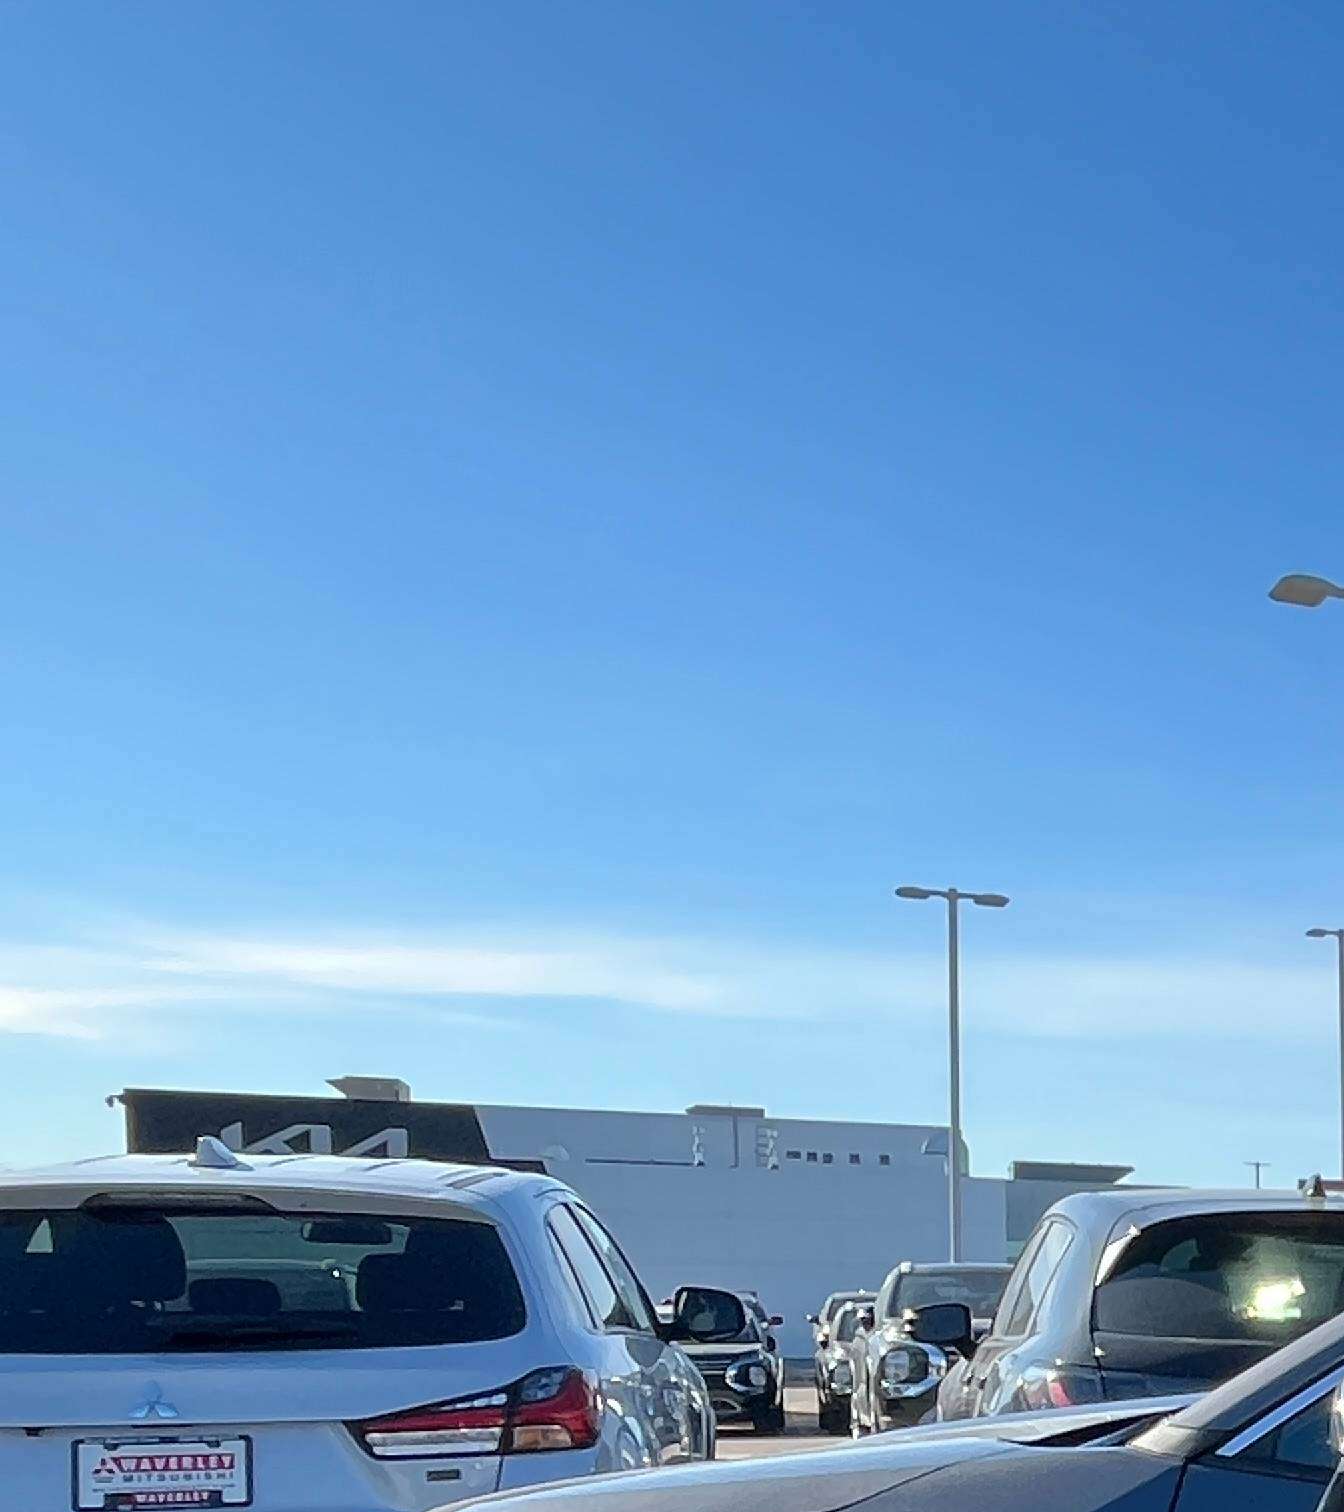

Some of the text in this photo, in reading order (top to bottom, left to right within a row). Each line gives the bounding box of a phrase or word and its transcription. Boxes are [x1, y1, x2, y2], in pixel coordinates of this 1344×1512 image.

[119, 1456, 234, 1472] WAVERLEY
[122, 1471, 234, 1483] MITSUBISHI
[135, 1491, 209, 1503] WAVERLEY
